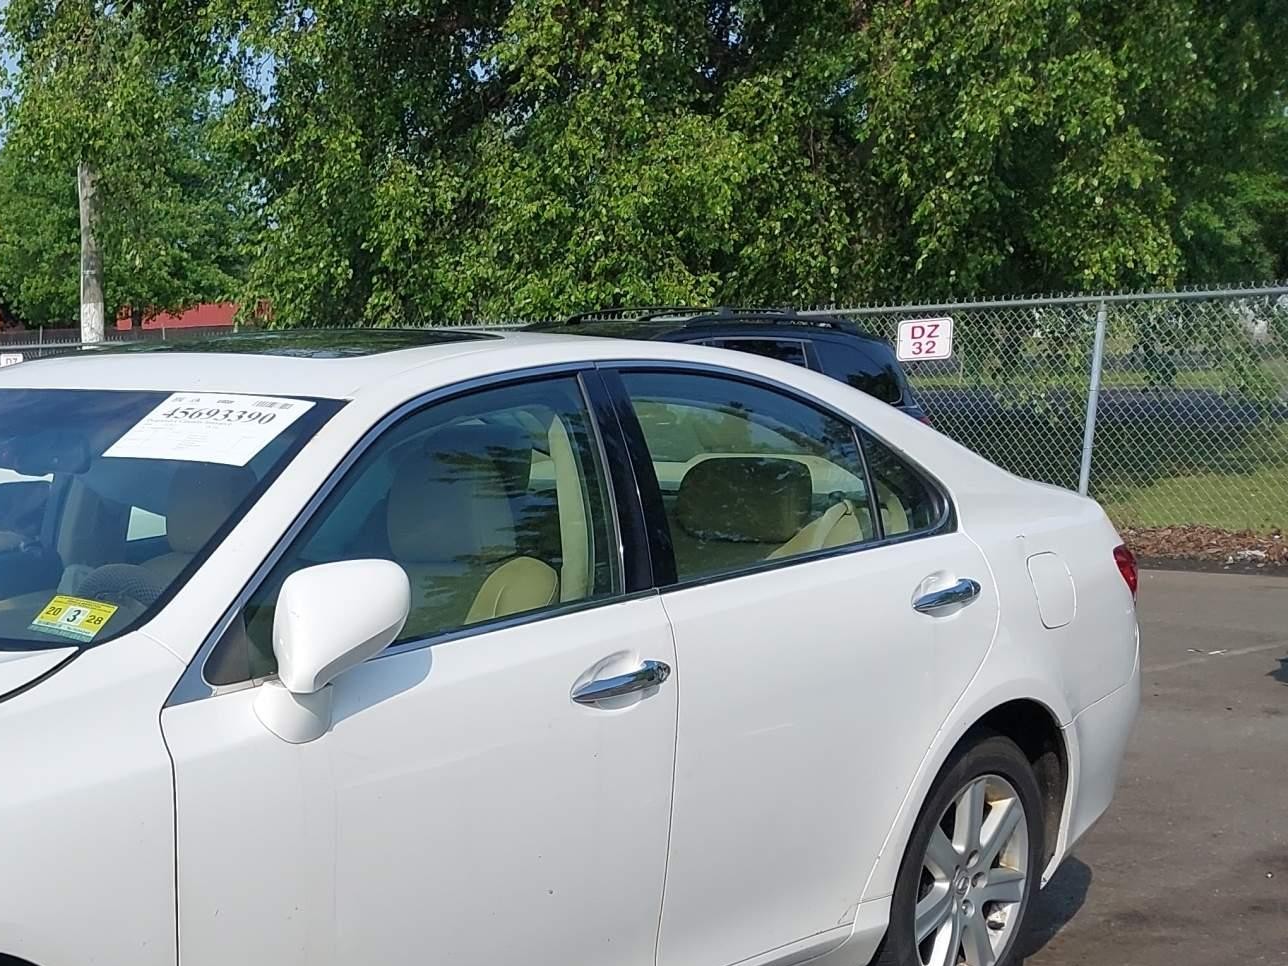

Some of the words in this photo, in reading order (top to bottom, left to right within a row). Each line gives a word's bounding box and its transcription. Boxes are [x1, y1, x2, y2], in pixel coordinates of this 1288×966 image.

[911, 324, 940, 340] DZ
[912, 341, 937, 355] 32
[162, 406, 277, 425] 45693390
[45, 606, 62, 616] 20
[66, 609, 82, 623] 3
[85, 614, 104, 626] 28
